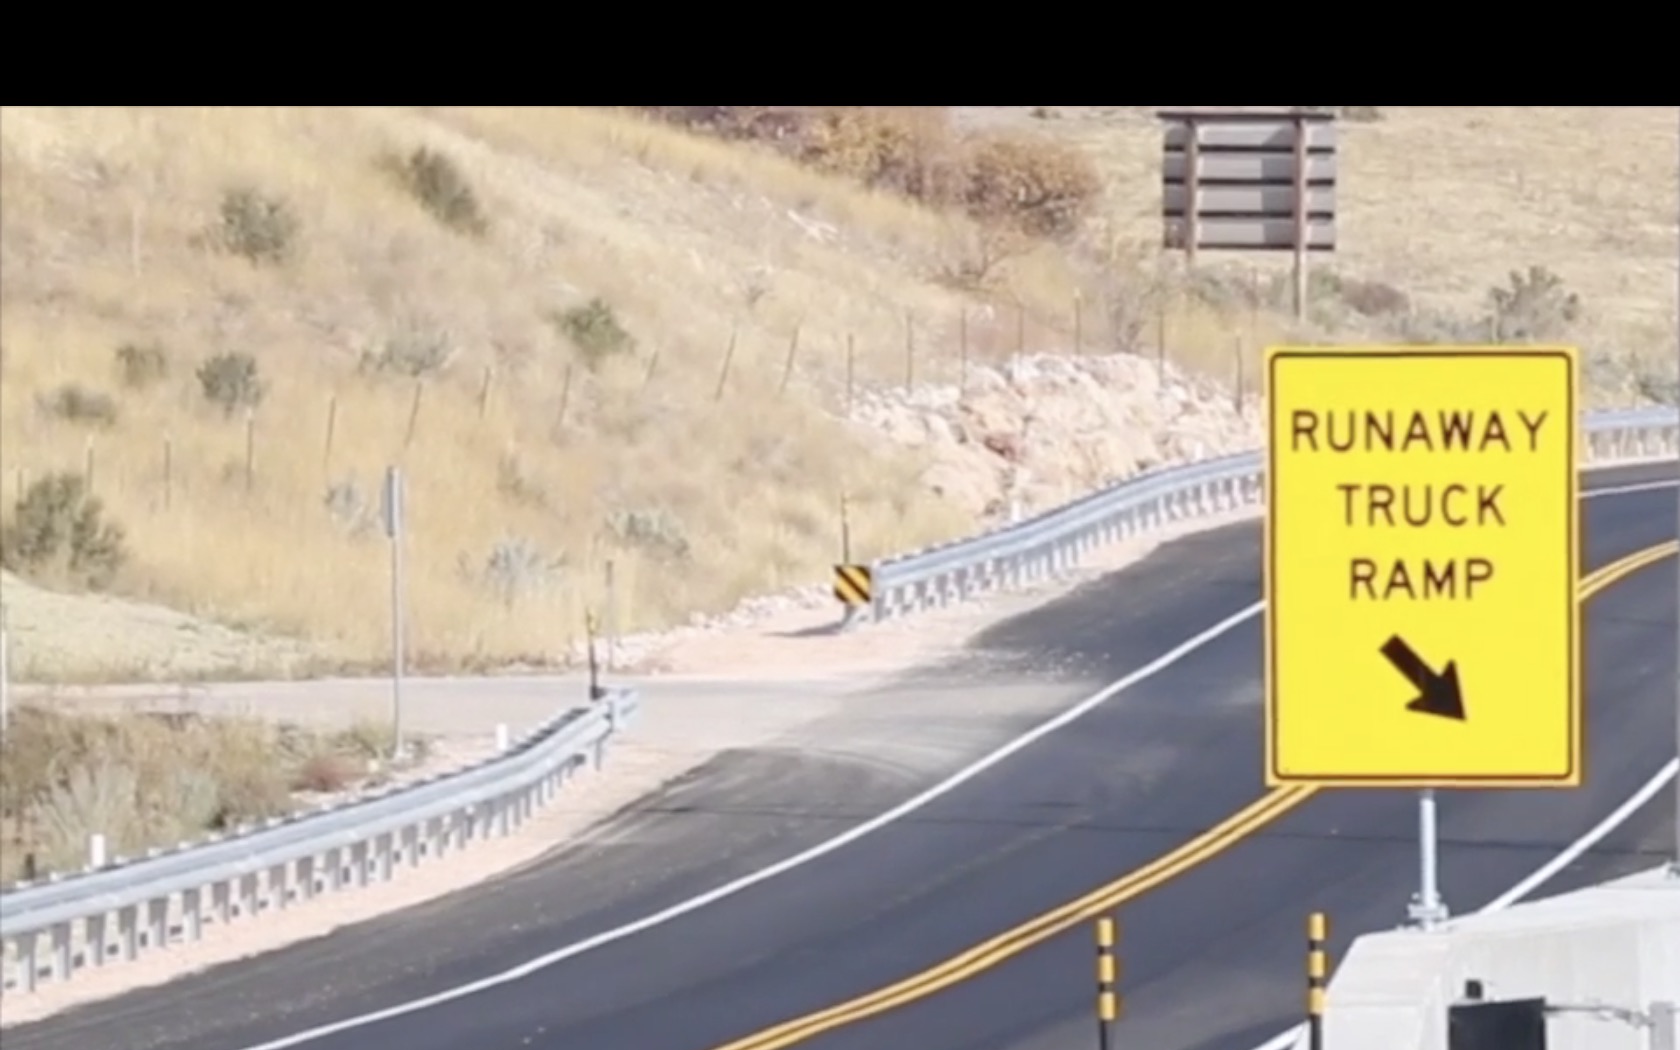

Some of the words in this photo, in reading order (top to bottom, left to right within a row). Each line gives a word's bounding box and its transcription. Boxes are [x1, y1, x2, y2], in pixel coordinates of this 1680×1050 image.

[1292, 409, 1548, 452] RUNAWAY
[1337, 484, 1506, 527] TRUCK
[1350, 558, 1494, 600] RAMP
